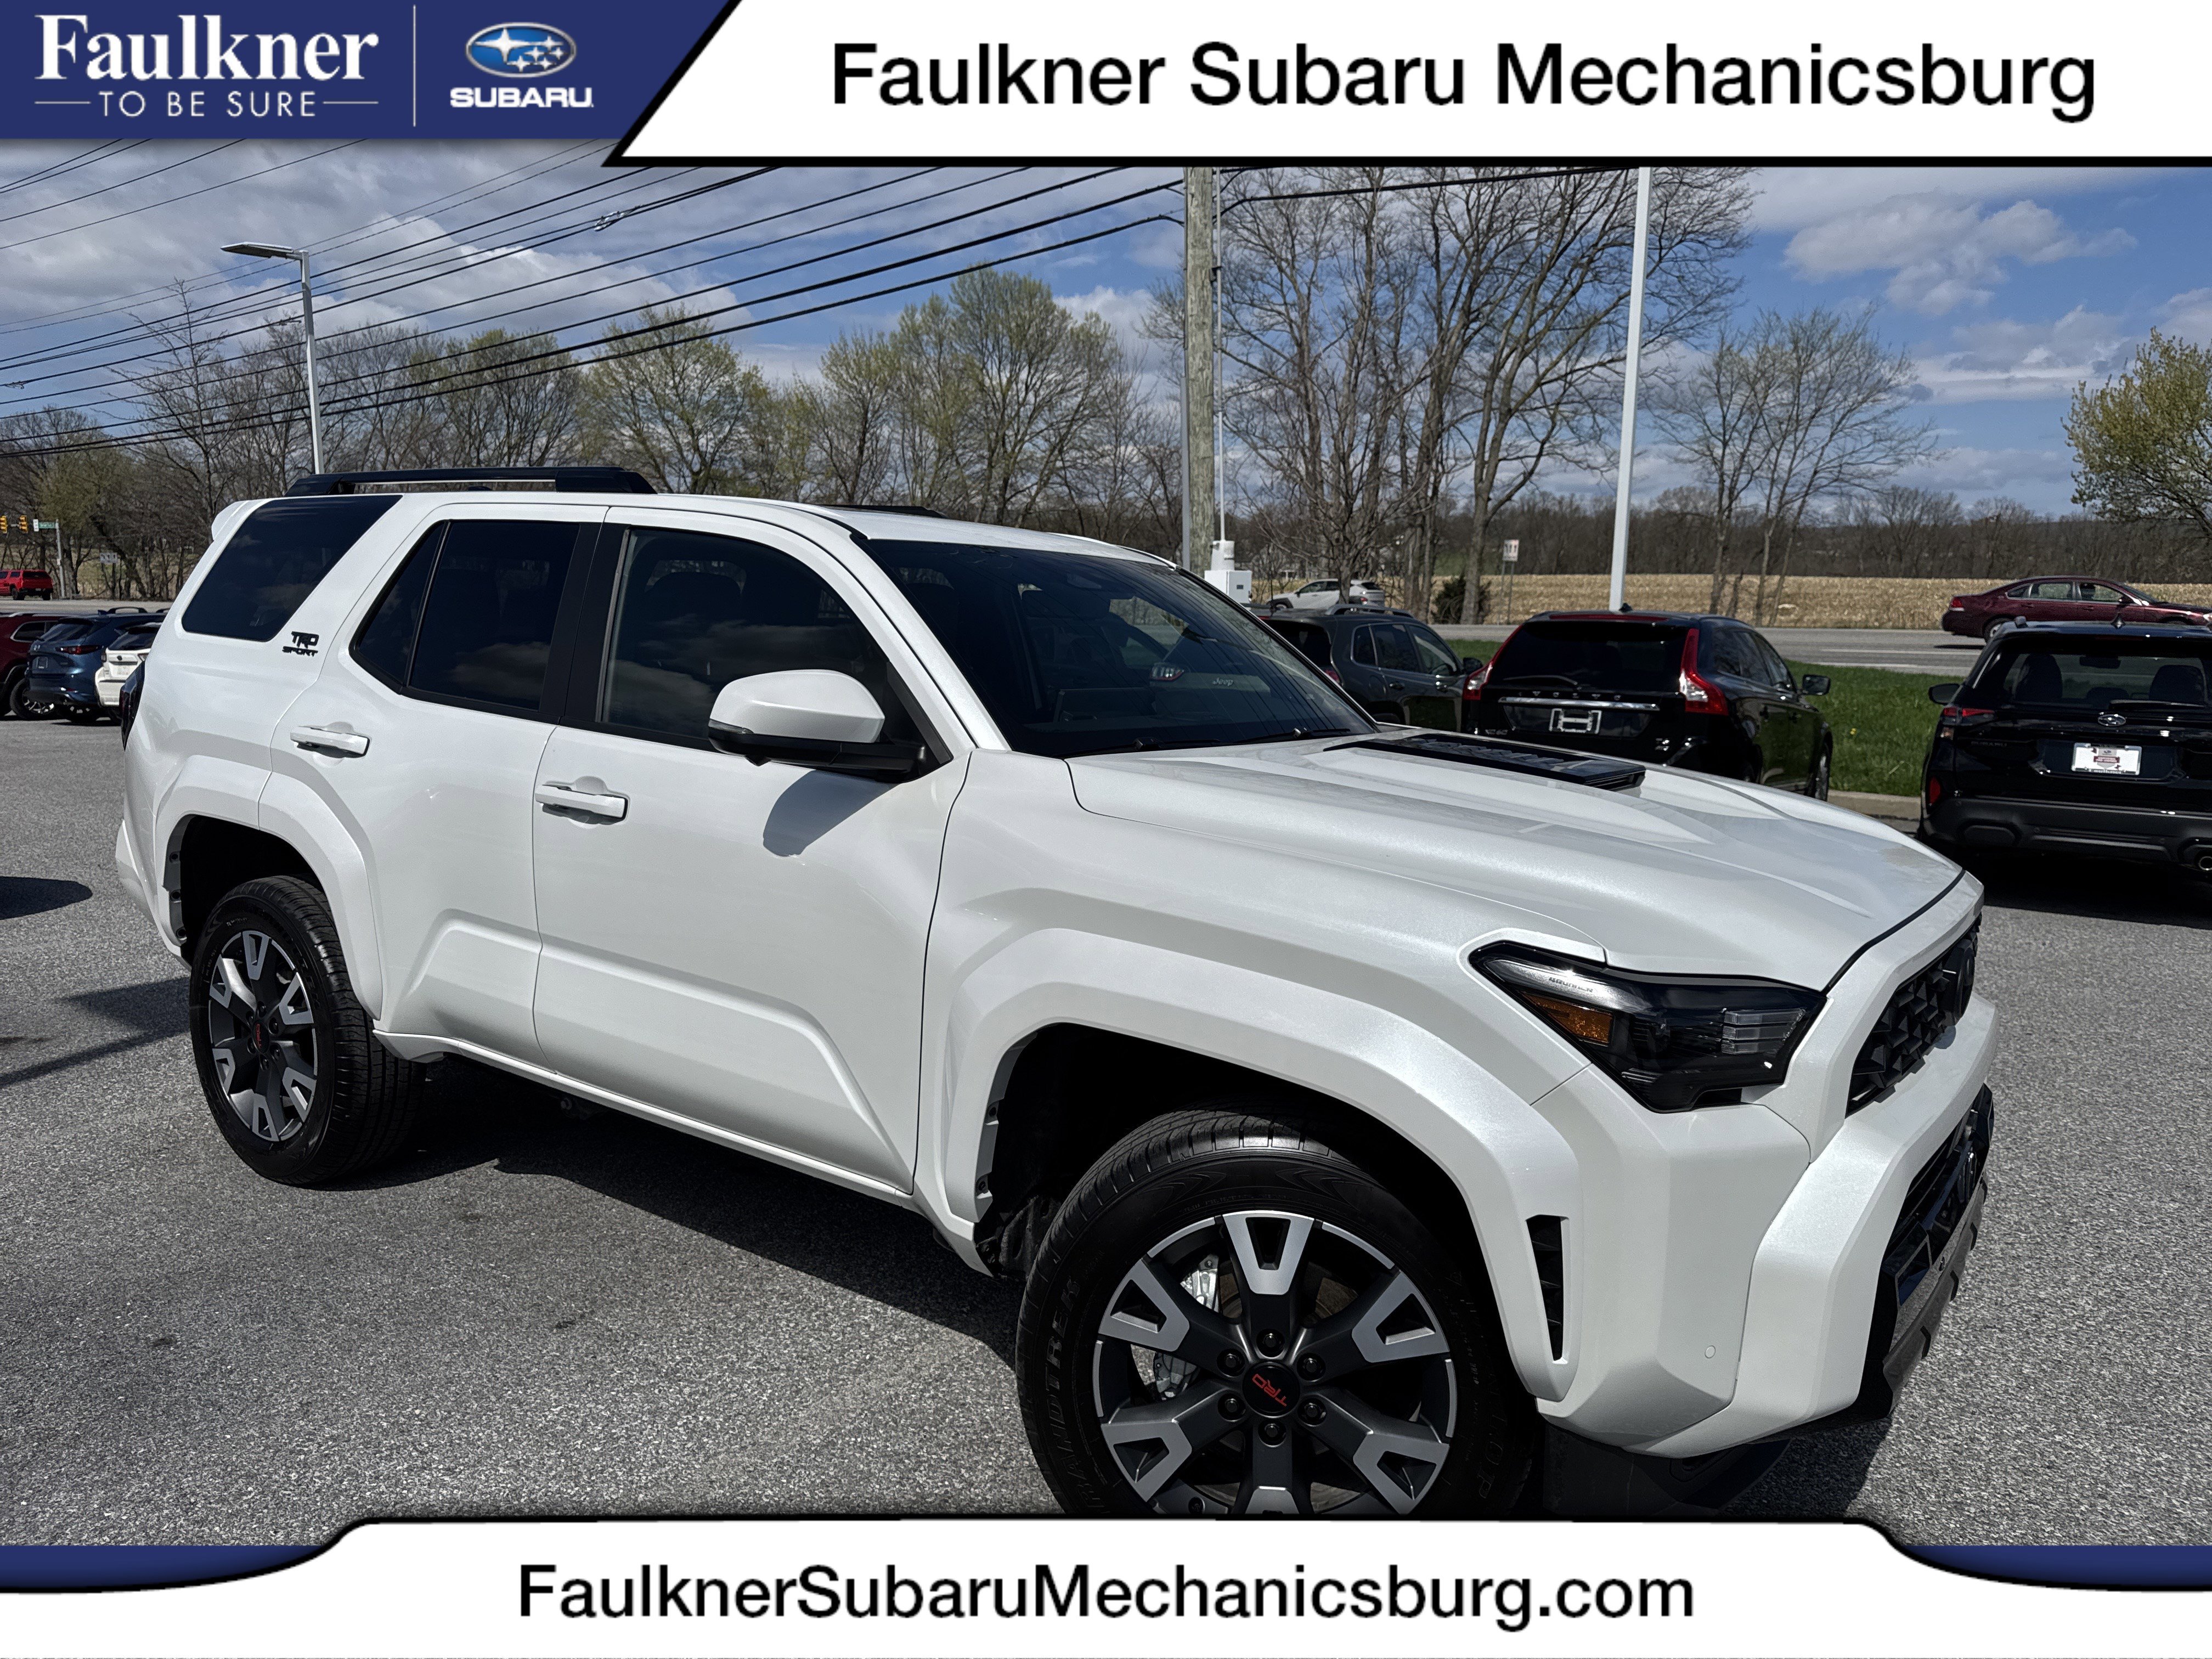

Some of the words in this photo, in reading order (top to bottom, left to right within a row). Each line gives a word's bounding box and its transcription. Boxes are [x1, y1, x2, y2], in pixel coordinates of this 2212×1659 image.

[291, 631, 319, 648] TRD
[282, 646, 318, 657] SPORT
[1212, 677, 1234, 686] Jeep
[1252, 1373, 1288, 1407] TRD
